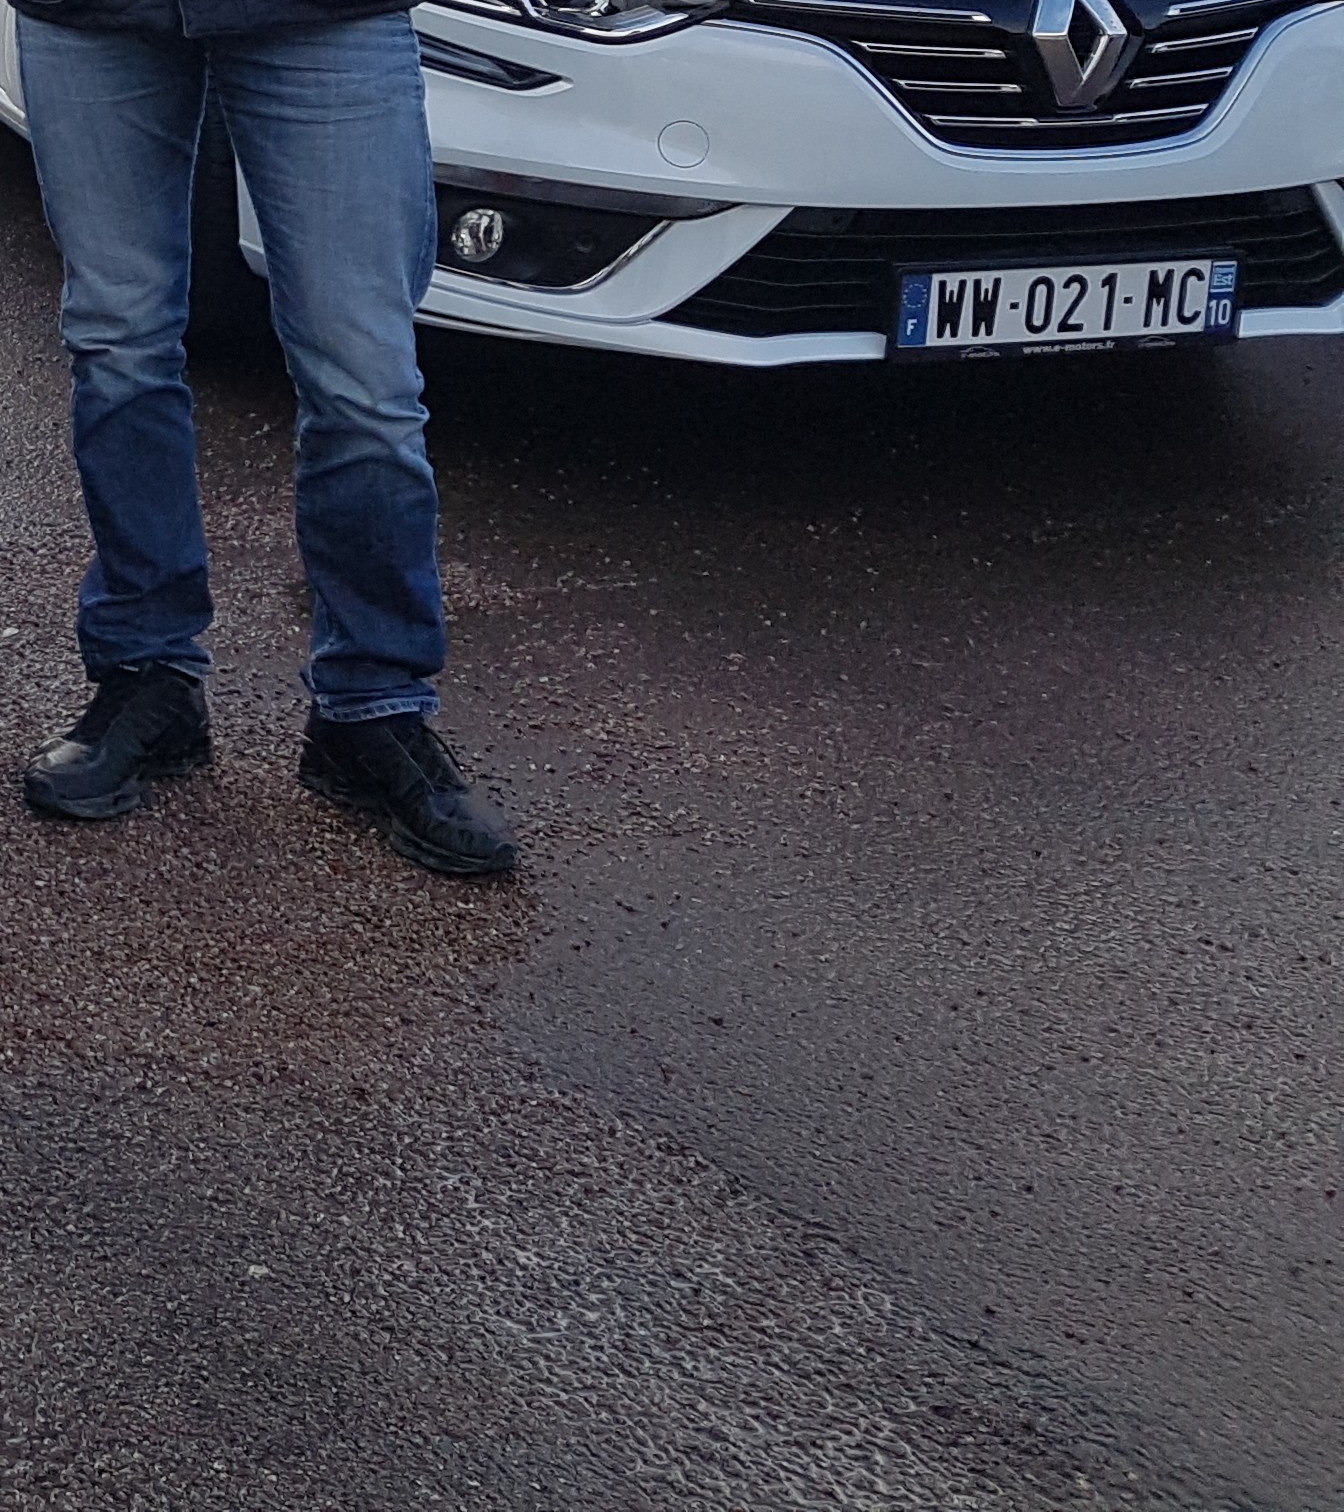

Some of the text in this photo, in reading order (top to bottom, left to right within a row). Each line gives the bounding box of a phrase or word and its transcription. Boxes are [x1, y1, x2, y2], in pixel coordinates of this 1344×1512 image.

[936, 266, 1206, 339] WW-021-MC
[1209, 299, 1232, 326] 10
[906, 319, 918, 336] F
[1023, 340, 1116, 355] www.e-motors.fr
